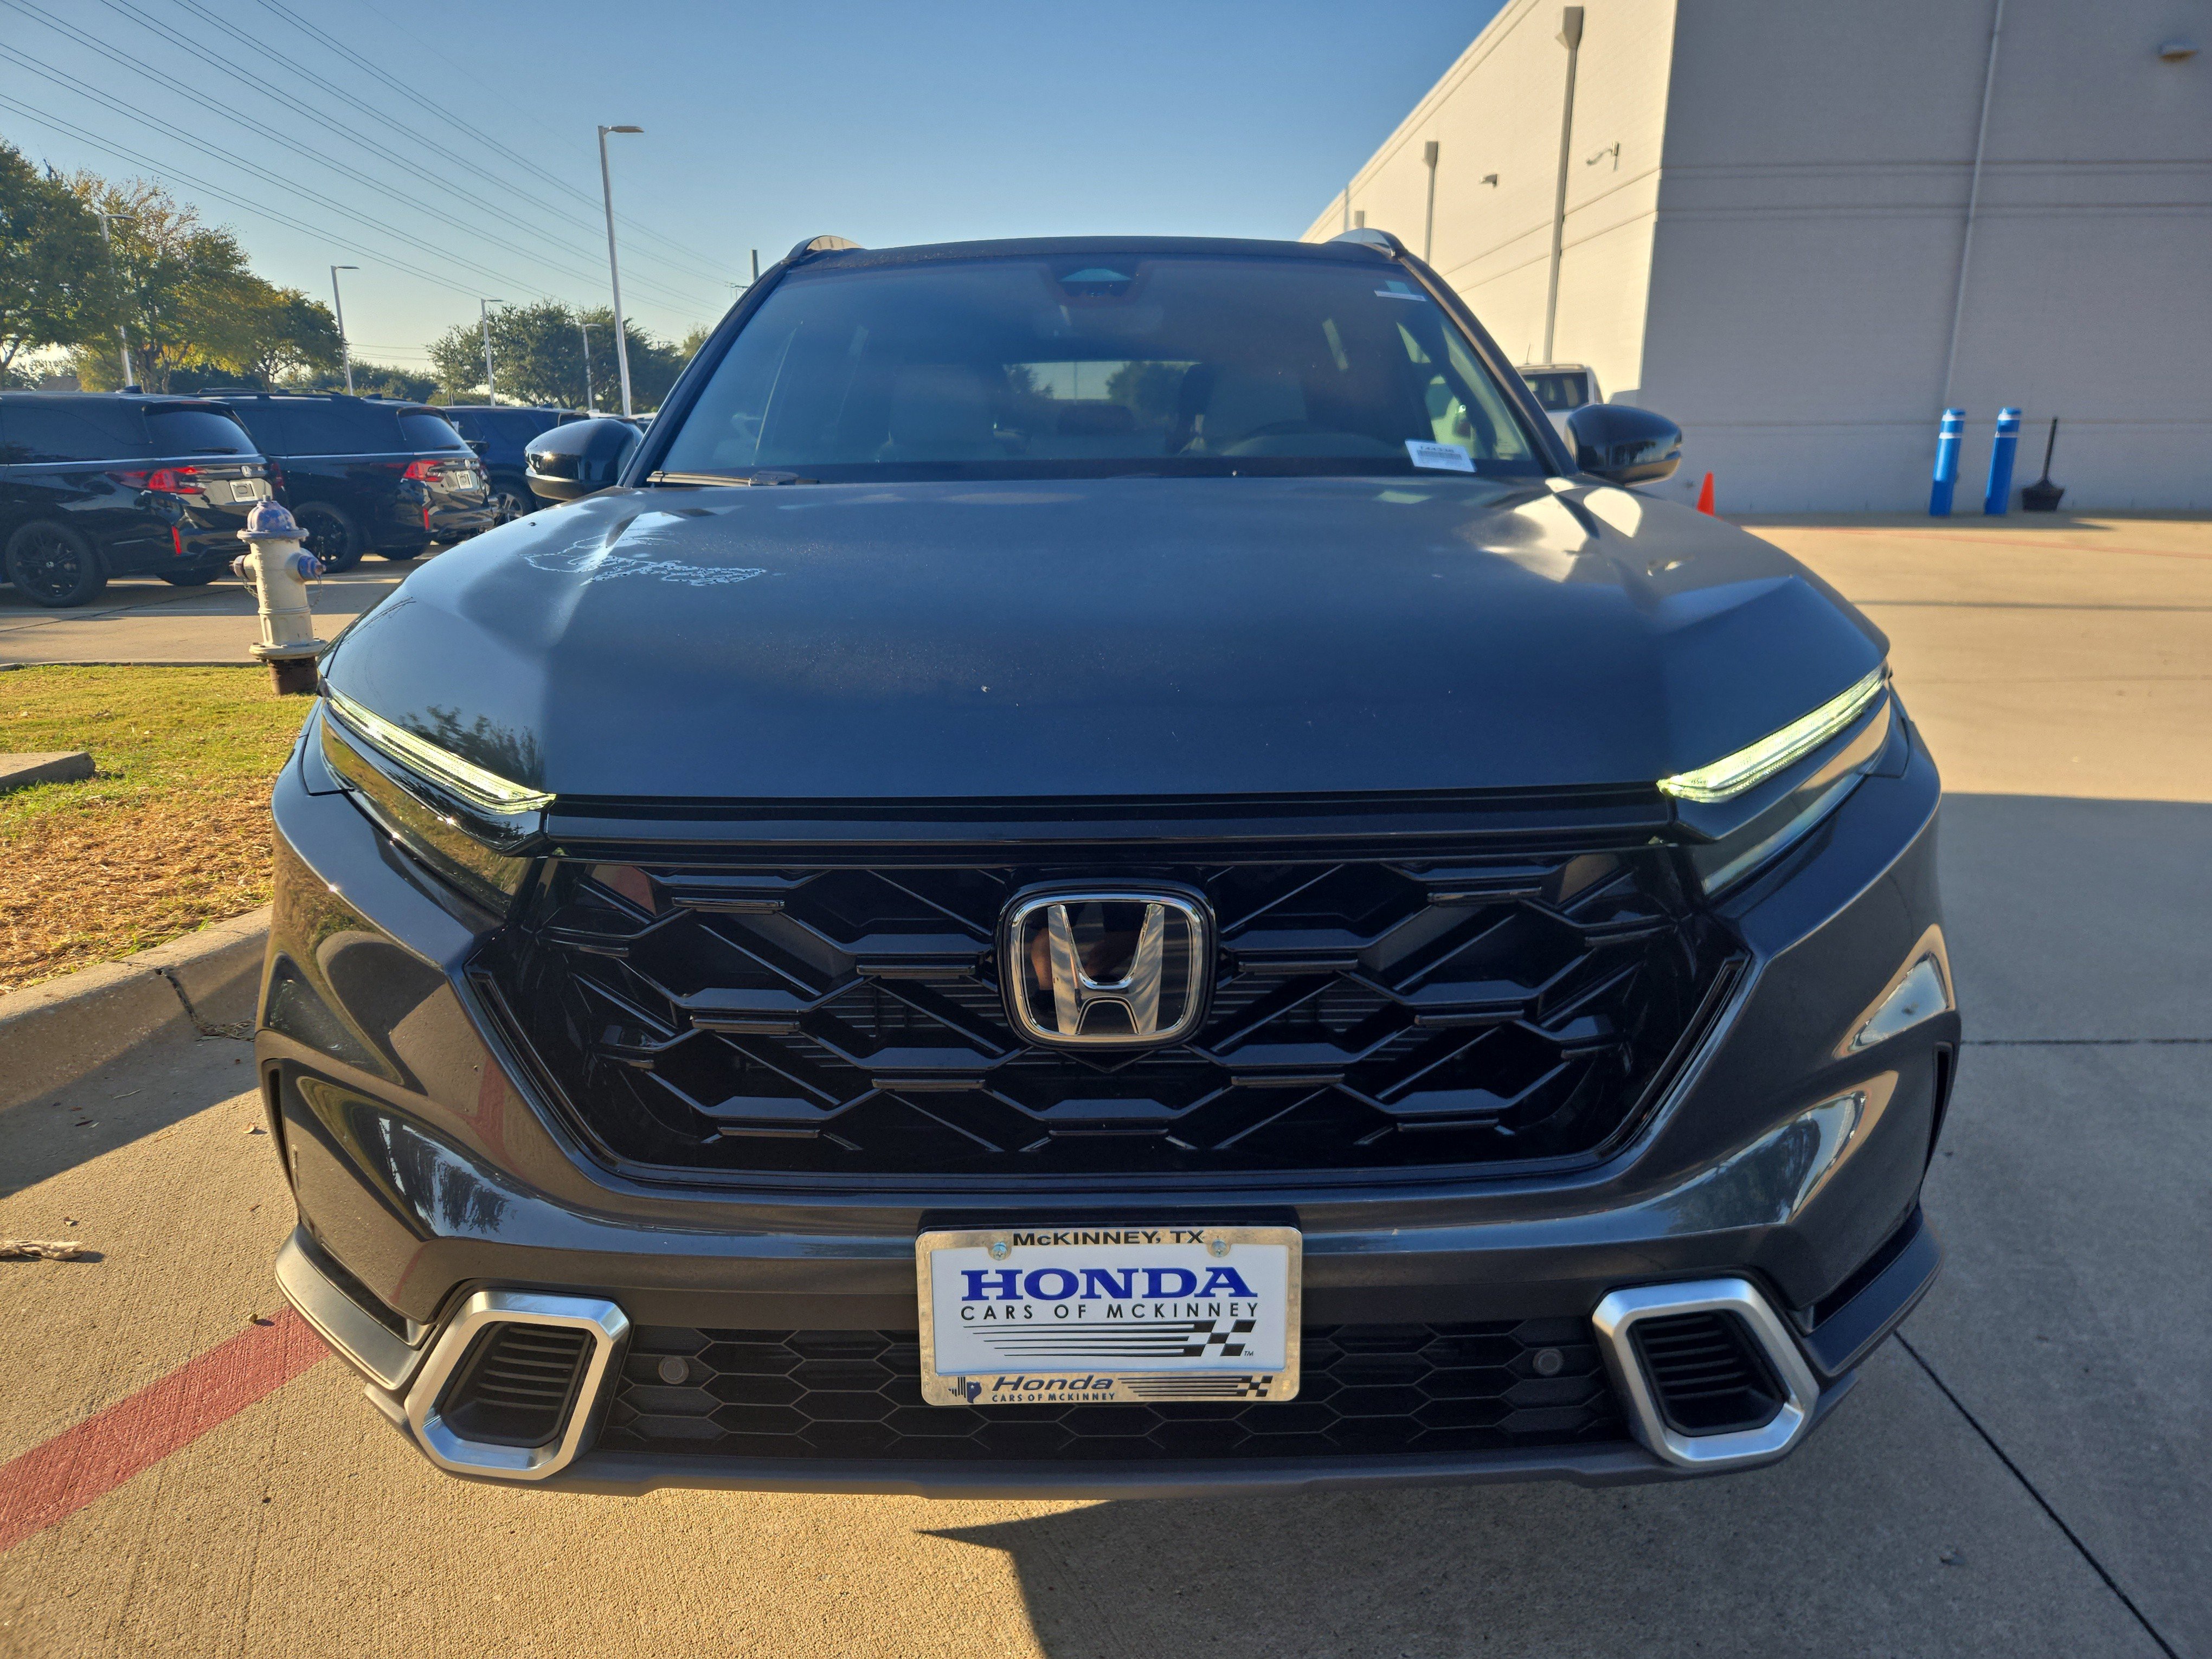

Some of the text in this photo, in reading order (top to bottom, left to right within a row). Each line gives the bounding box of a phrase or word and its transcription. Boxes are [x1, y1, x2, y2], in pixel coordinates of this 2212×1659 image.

[1013, 1230, 1204, 1246] McKINNEY, TX
[961, 1267, 1258, 1301] HONDA
[961, 1302, 1258, 1321] CARS OF MCKINNEY
[992, 1374, 1114, 1391] Honda
[992, 1392, 1115, 1403] CARS OF MCKINNEY
